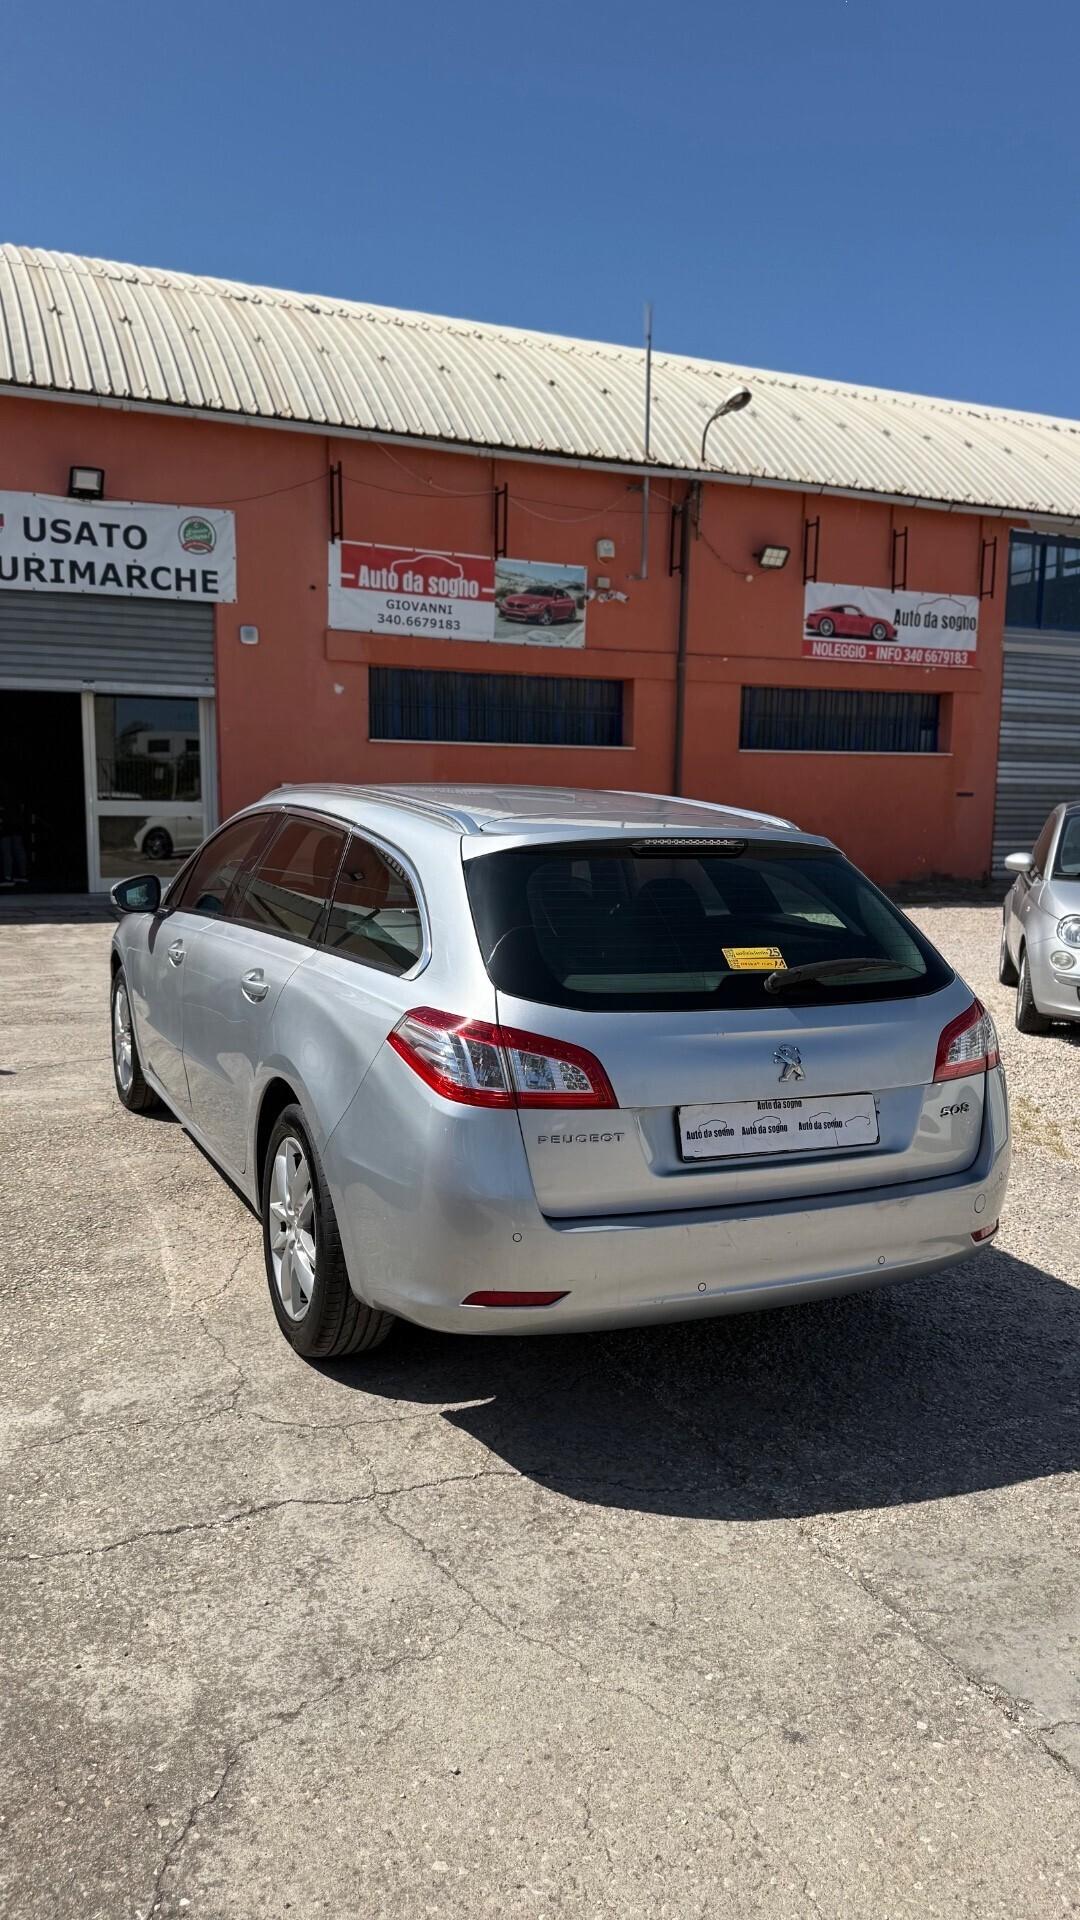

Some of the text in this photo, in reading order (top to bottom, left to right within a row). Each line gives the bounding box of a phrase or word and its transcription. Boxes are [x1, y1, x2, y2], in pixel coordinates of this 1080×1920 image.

[23, 516, 148, 550] USATO
[0, 556, 220, 594] URIMARCHE
[358, 565, 479, 598] Auto da sogno
[386, 599, 453, 615] GIOVANNI
[377, 613, 461, 630] 340.6679183
[893, 609, 976, 631] Auto da sogno
[812, 642, 866, 659] NOLEGGIO
[876, 647, 902, 661] INFO
[904, 649, 922, 662] 340
[925, 650, 968, 664] 6679183
[757, 1099, 802, 1110] Auto da sogno
[741, 1124, 788, 1136] Auto da sogno
[798, 1121, 813, 1131] Auto
[813, 1120, 822, 1130] da
[538, 1132, 625, 1144] PEUGEOT
[686, 1130, 702, 1140] Auto
[703, 1129, 712, 1138] da
